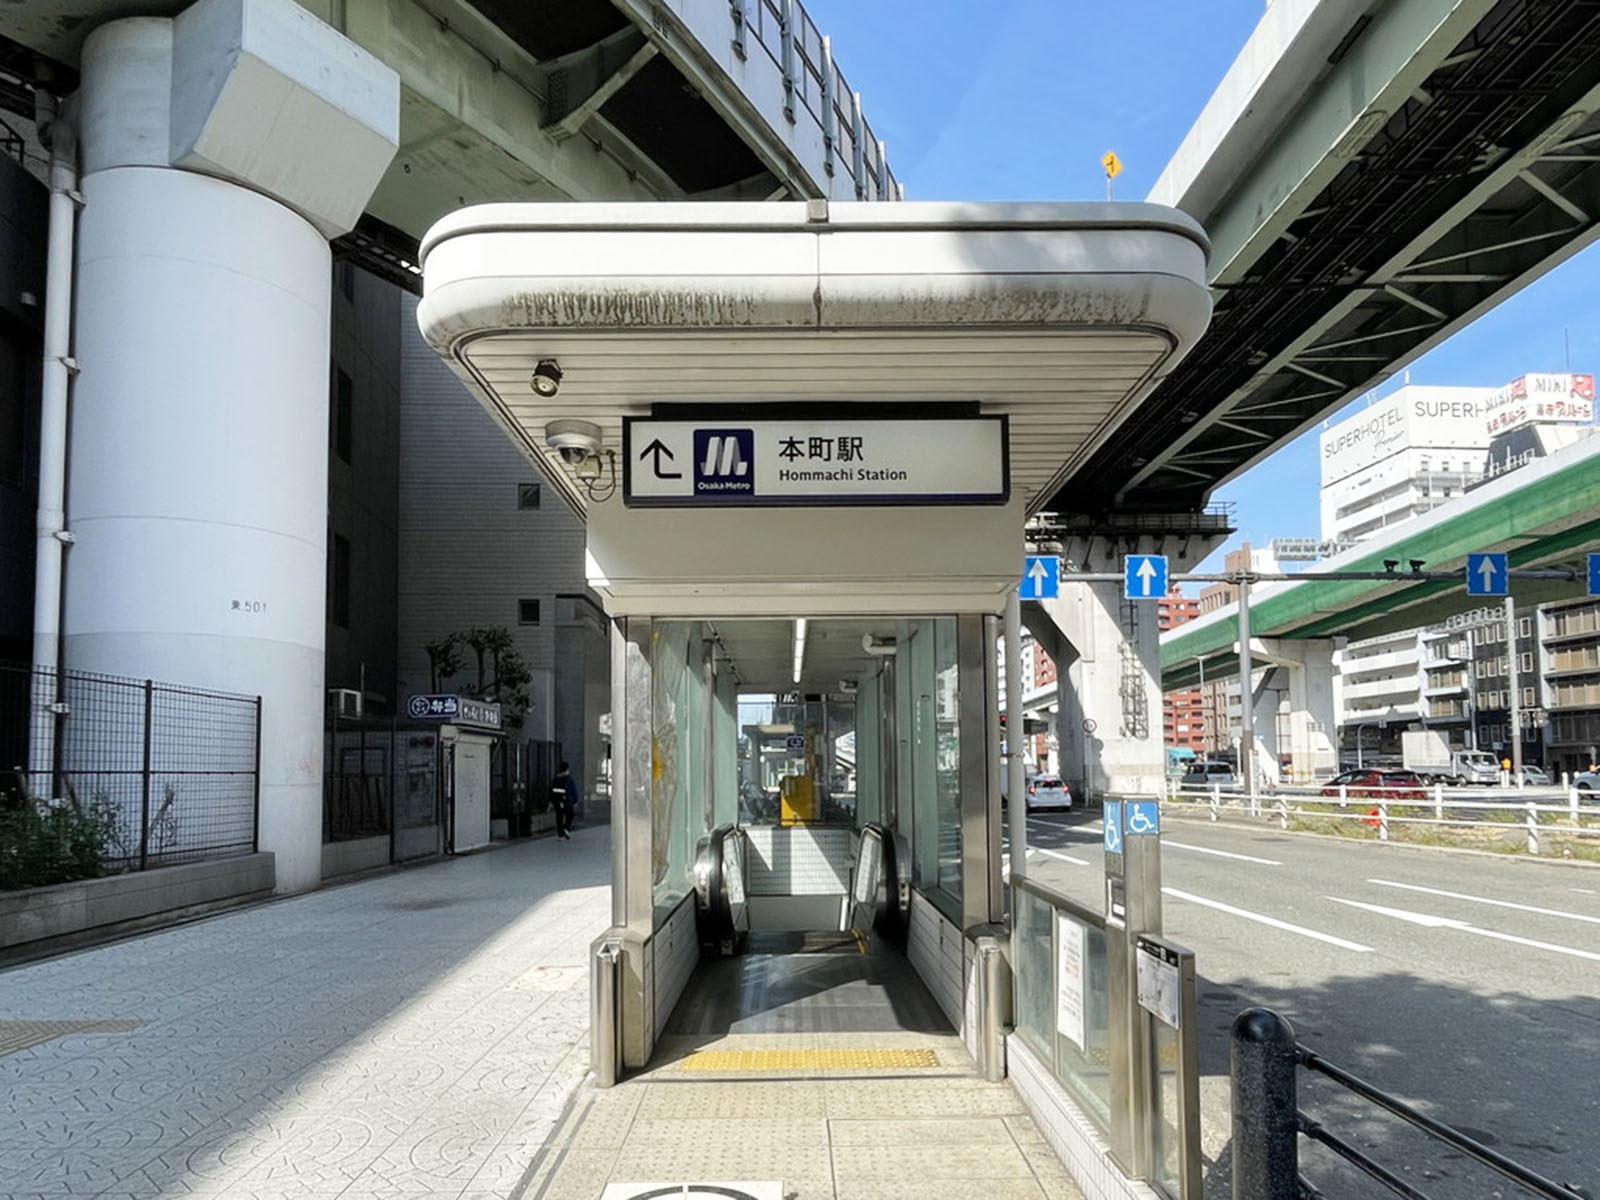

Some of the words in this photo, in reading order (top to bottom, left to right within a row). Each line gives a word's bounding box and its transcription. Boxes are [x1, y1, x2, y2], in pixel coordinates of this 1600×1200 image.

[1535, 378, 1567, 393] MIKI
[1325, 407, 1403, 459] SUPERHOTEL
[779, 436, 863, 462] 本町駅
[779, 469, 854, 481] Hommachi
[857, 468, 908, 481] Station
[698, 481, 724, 490] Osaka
[725, 482, 751, 490] Metro
